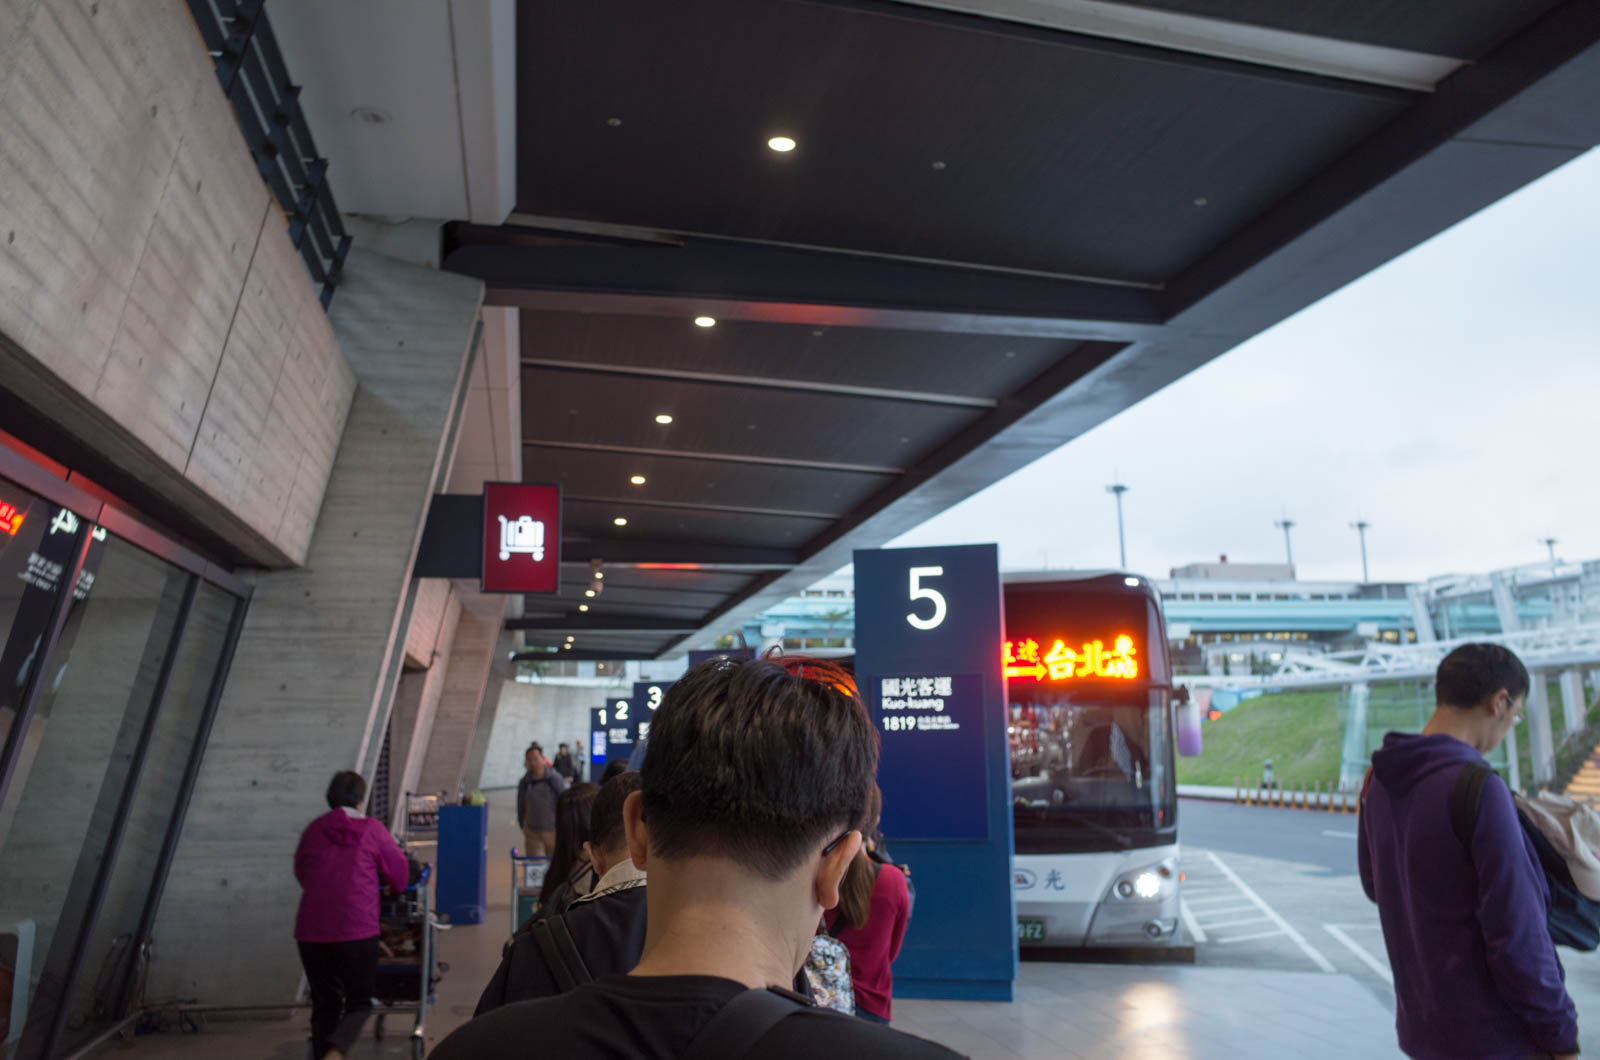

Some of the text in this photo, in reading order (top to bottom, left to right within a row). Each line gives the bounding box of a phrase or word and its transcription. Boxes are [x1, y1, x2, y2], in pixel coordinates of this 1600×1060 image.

[906, 565, 948, 631] 5
[647, 686, 662, 710] 3
[598, 709, 607, 725] 1
[615, 700, 628, 720] 2
[882, 715, 917, 732] 1819
[1044, 868, 1065, 891] 光
